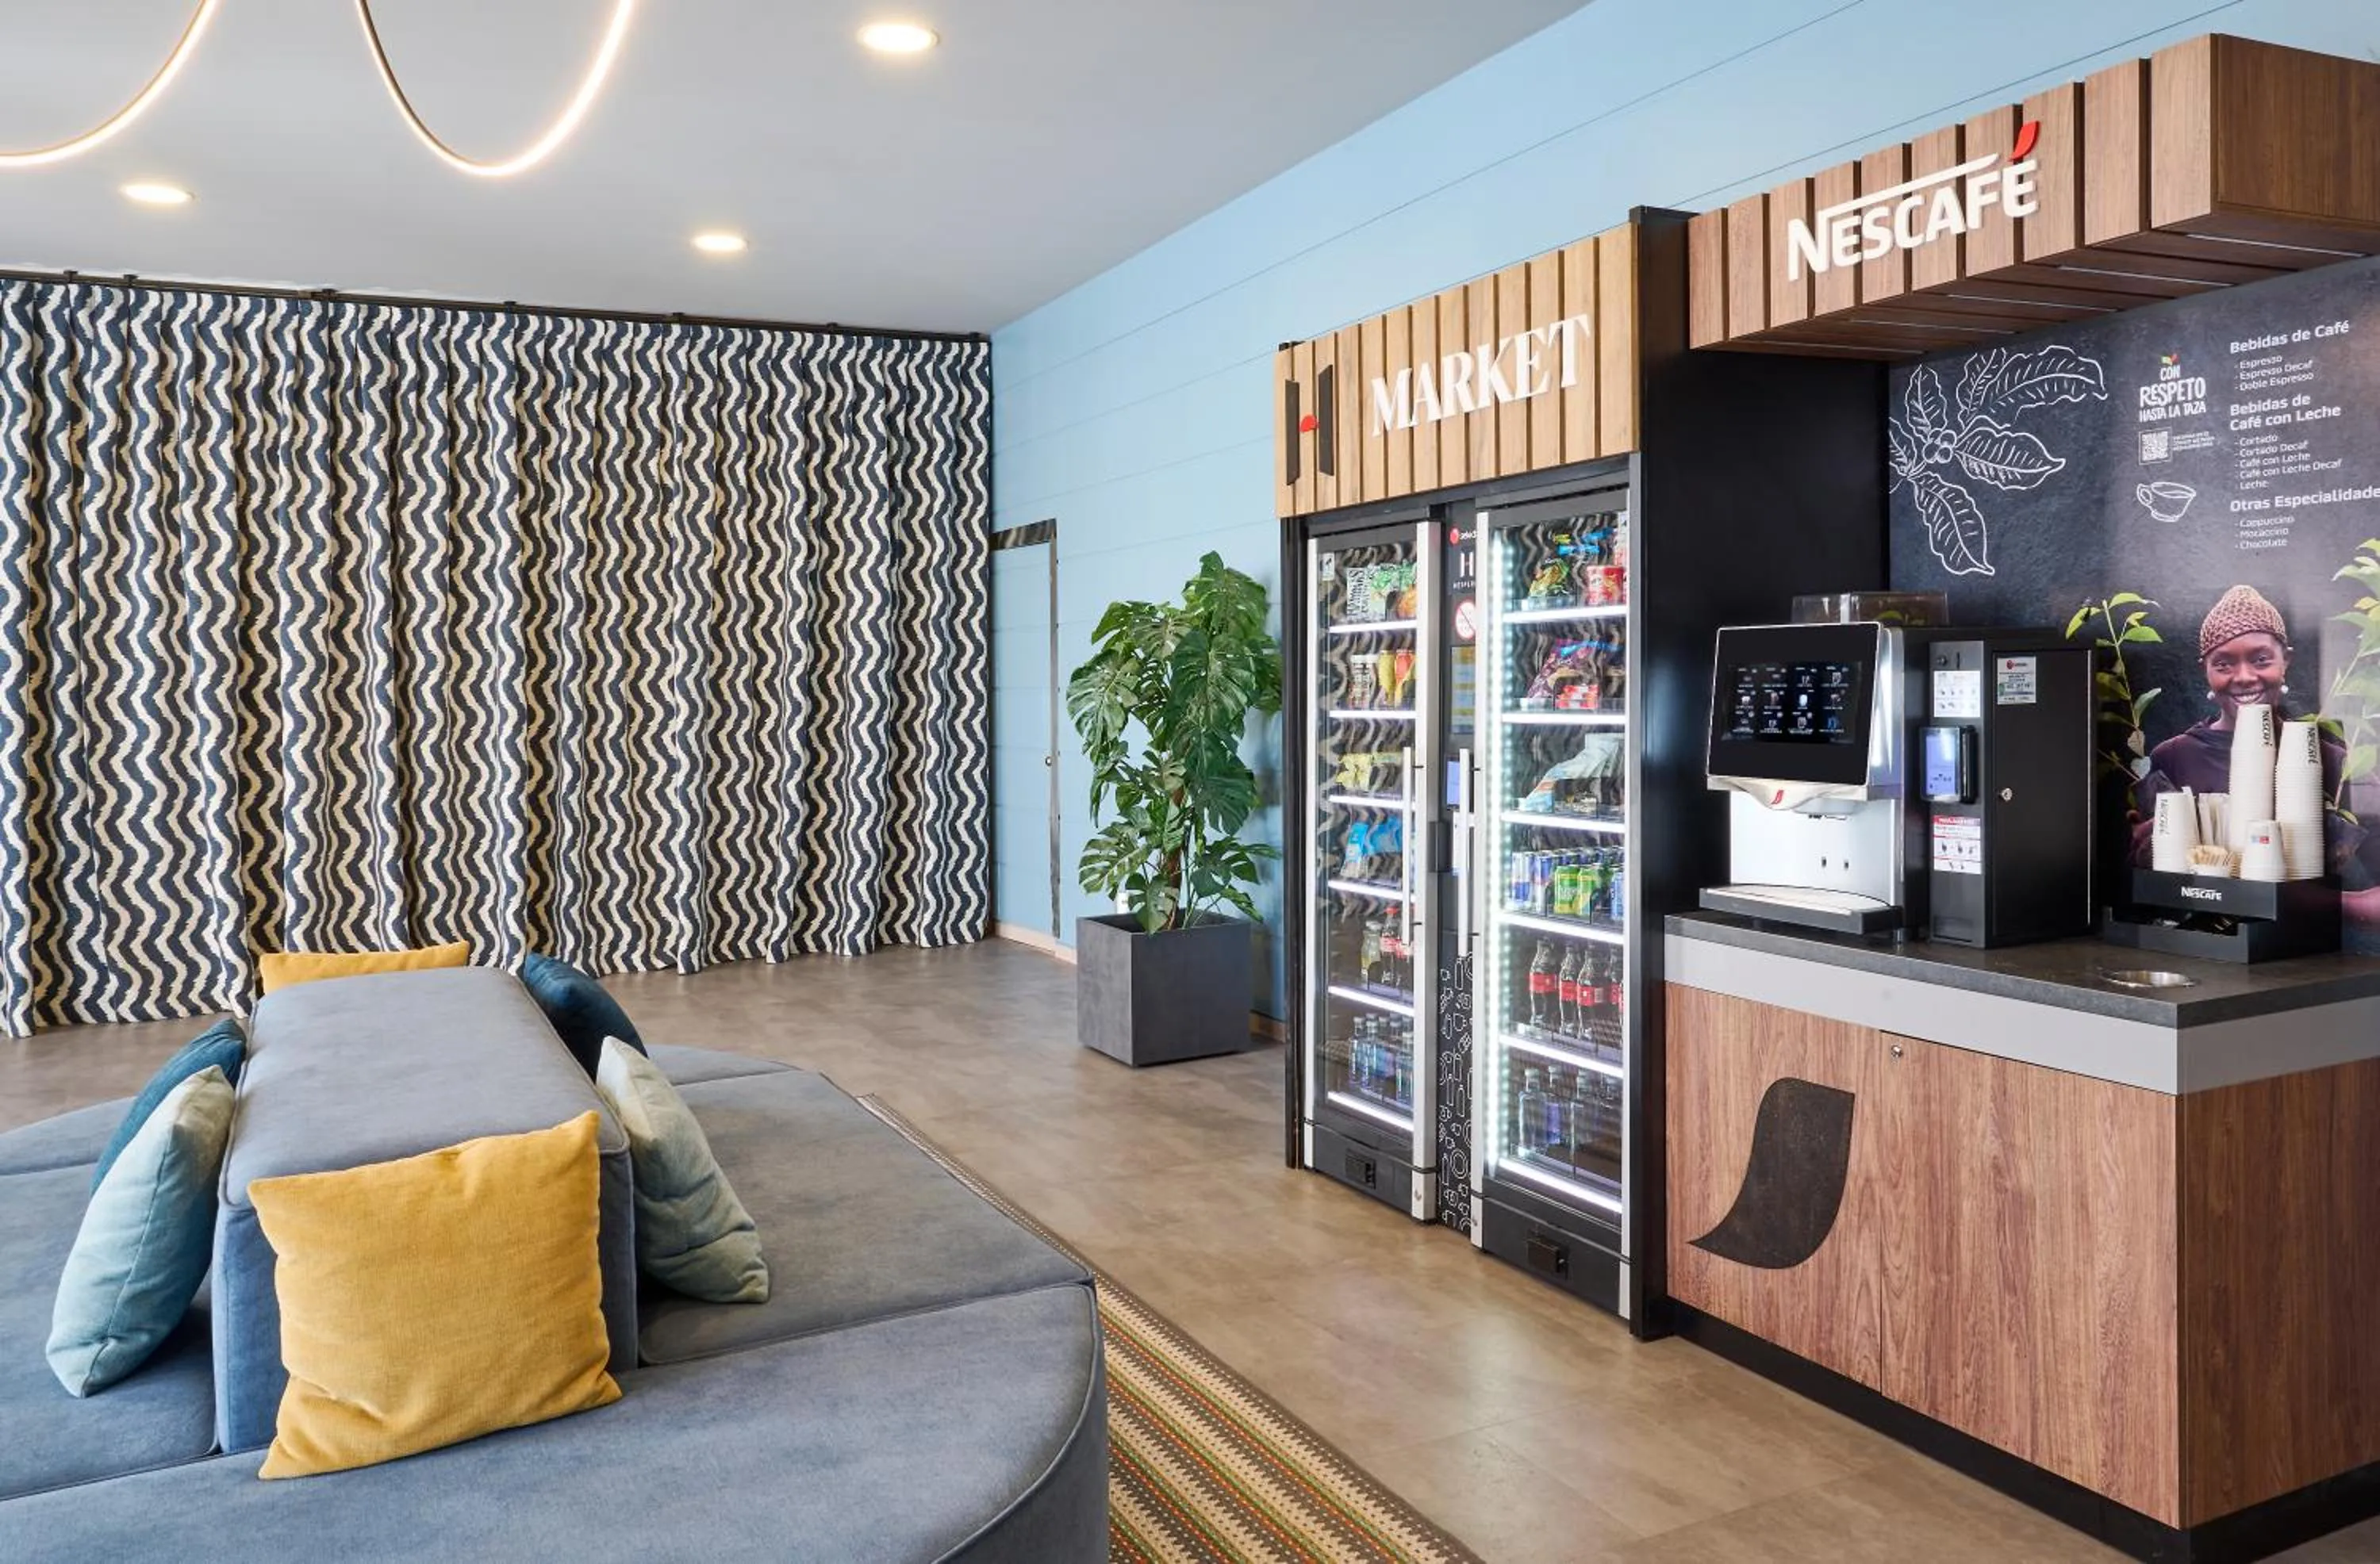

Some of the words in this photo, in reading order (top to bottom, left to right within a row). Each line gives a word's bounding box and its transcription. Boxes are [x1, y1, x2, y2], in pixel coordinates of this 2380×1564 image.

[1787, 121, 2040, 282] NESCAFÉ
[2230, 333, 2289, 354] Bebidas
[2291, 329, 2311, 342] de
[2314, 320, 2349, 337] Café
[2240, 355, 2282, 370] Espresso
[2240, 366, 2282, 381] Espresso
[2285, 359, 2313, 372] Decaf
[1372, 314, 1591, 437] MARKET
[2160, 365, 2180, 381] CON
[2240, 379, 2268, 391] Doble
[2270, 372, 2314, 387] Espresso
[2140, 377, 2206, 408] RESPETO
[2139, 407, 2167, 422] HASTA
[2168, 404, 2181, 418] LA
[2182, 401, 2206, 416] TAZA
[2230, 398, 2289, 416] Bebidas
[2292, 393, 2311, 407] de
[2230, 416, 2262, 431] Café
[2265, 413, 2292, 426] con
[2296, 405, 2341, 421] Leche
[2240, 434, 2278, 447] Cortado
[2240, 446, 2278, 458] Cortado
[2280, 439, 2309, 452] Decaf
[2240, 458, 2260, 469] Café
[2262, 456, 2280, 465] con
[2282, 452, 2311, 463] Leche
[2240, 469, 2260, 479] Café
[2262, 468, 2280, 477] con
[2282, 463, 2311, 474] Leche
[2313, 458, 2343, 470] Decaf
[2240, 479, 2269, 490] Leche
[2230, 498, 2270, 512] Otras
[2240, 539, 2289, 550] Chocolate
